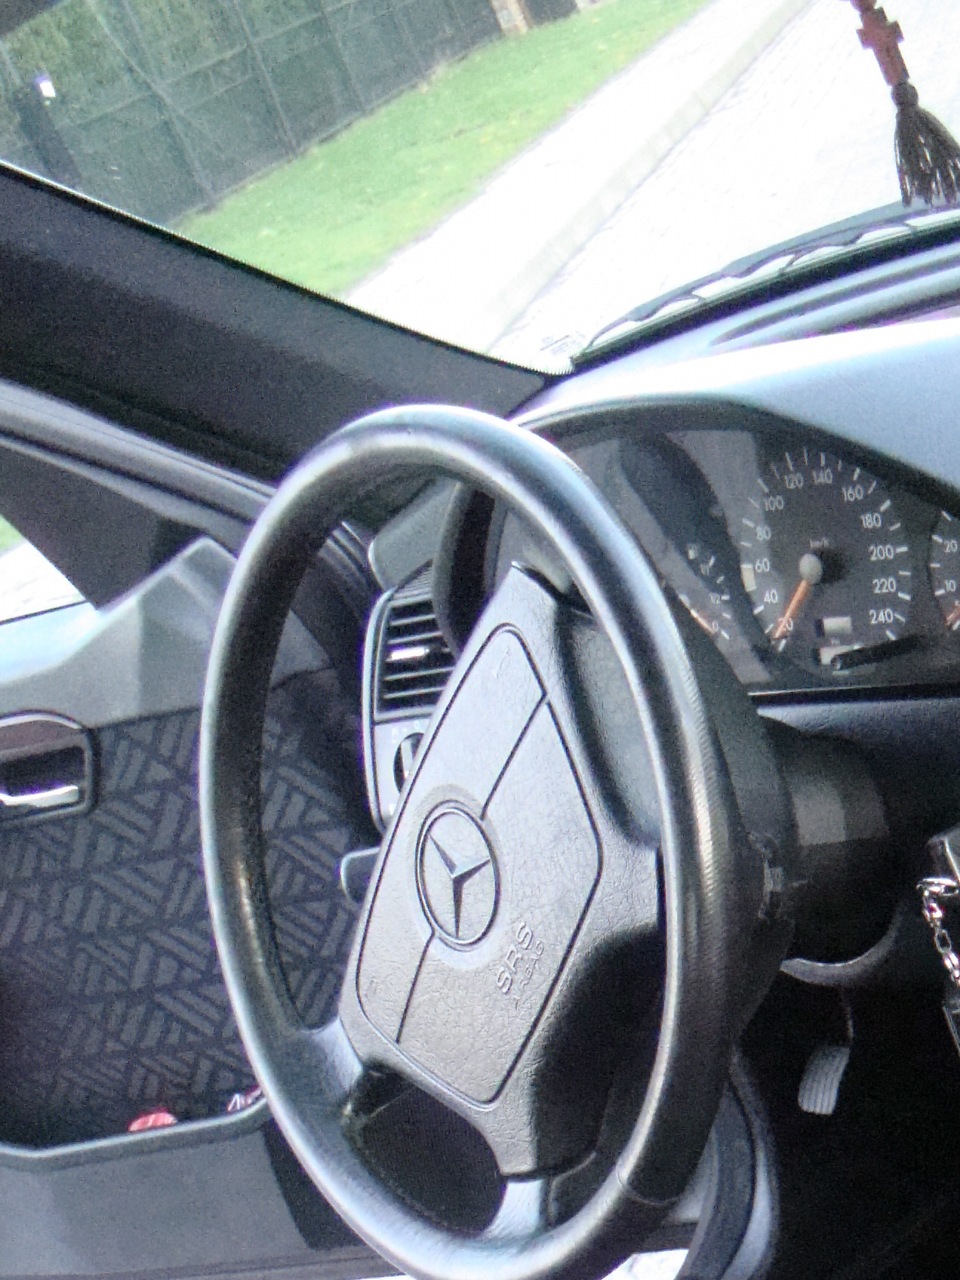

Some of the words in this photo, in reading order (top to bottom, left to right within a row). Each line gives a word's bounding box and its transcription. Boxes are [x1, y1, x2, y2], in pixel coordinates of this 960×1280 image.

[785, 472, 804, 489] 120
[813, 468, 833, 484] 140
[843, 484, 864, 501] 160
[765, 495, 784, 511] 100
[862, 512, 882, 529] 180
[756, 525, 771, 540] 80
[869, 544, 895, 561] 200
[944, 541, 958, 552] 20
[755, 558, 770, 572] 60
[873, 577, 896, 594] 220
[945, 580, 956, 592] 10
[764, 588, 778, 603] 40
[869, 608, 894, 624] 240
[496, 921, 534, 995] SRS
[512, 941, 545, 1011] ARBAG
